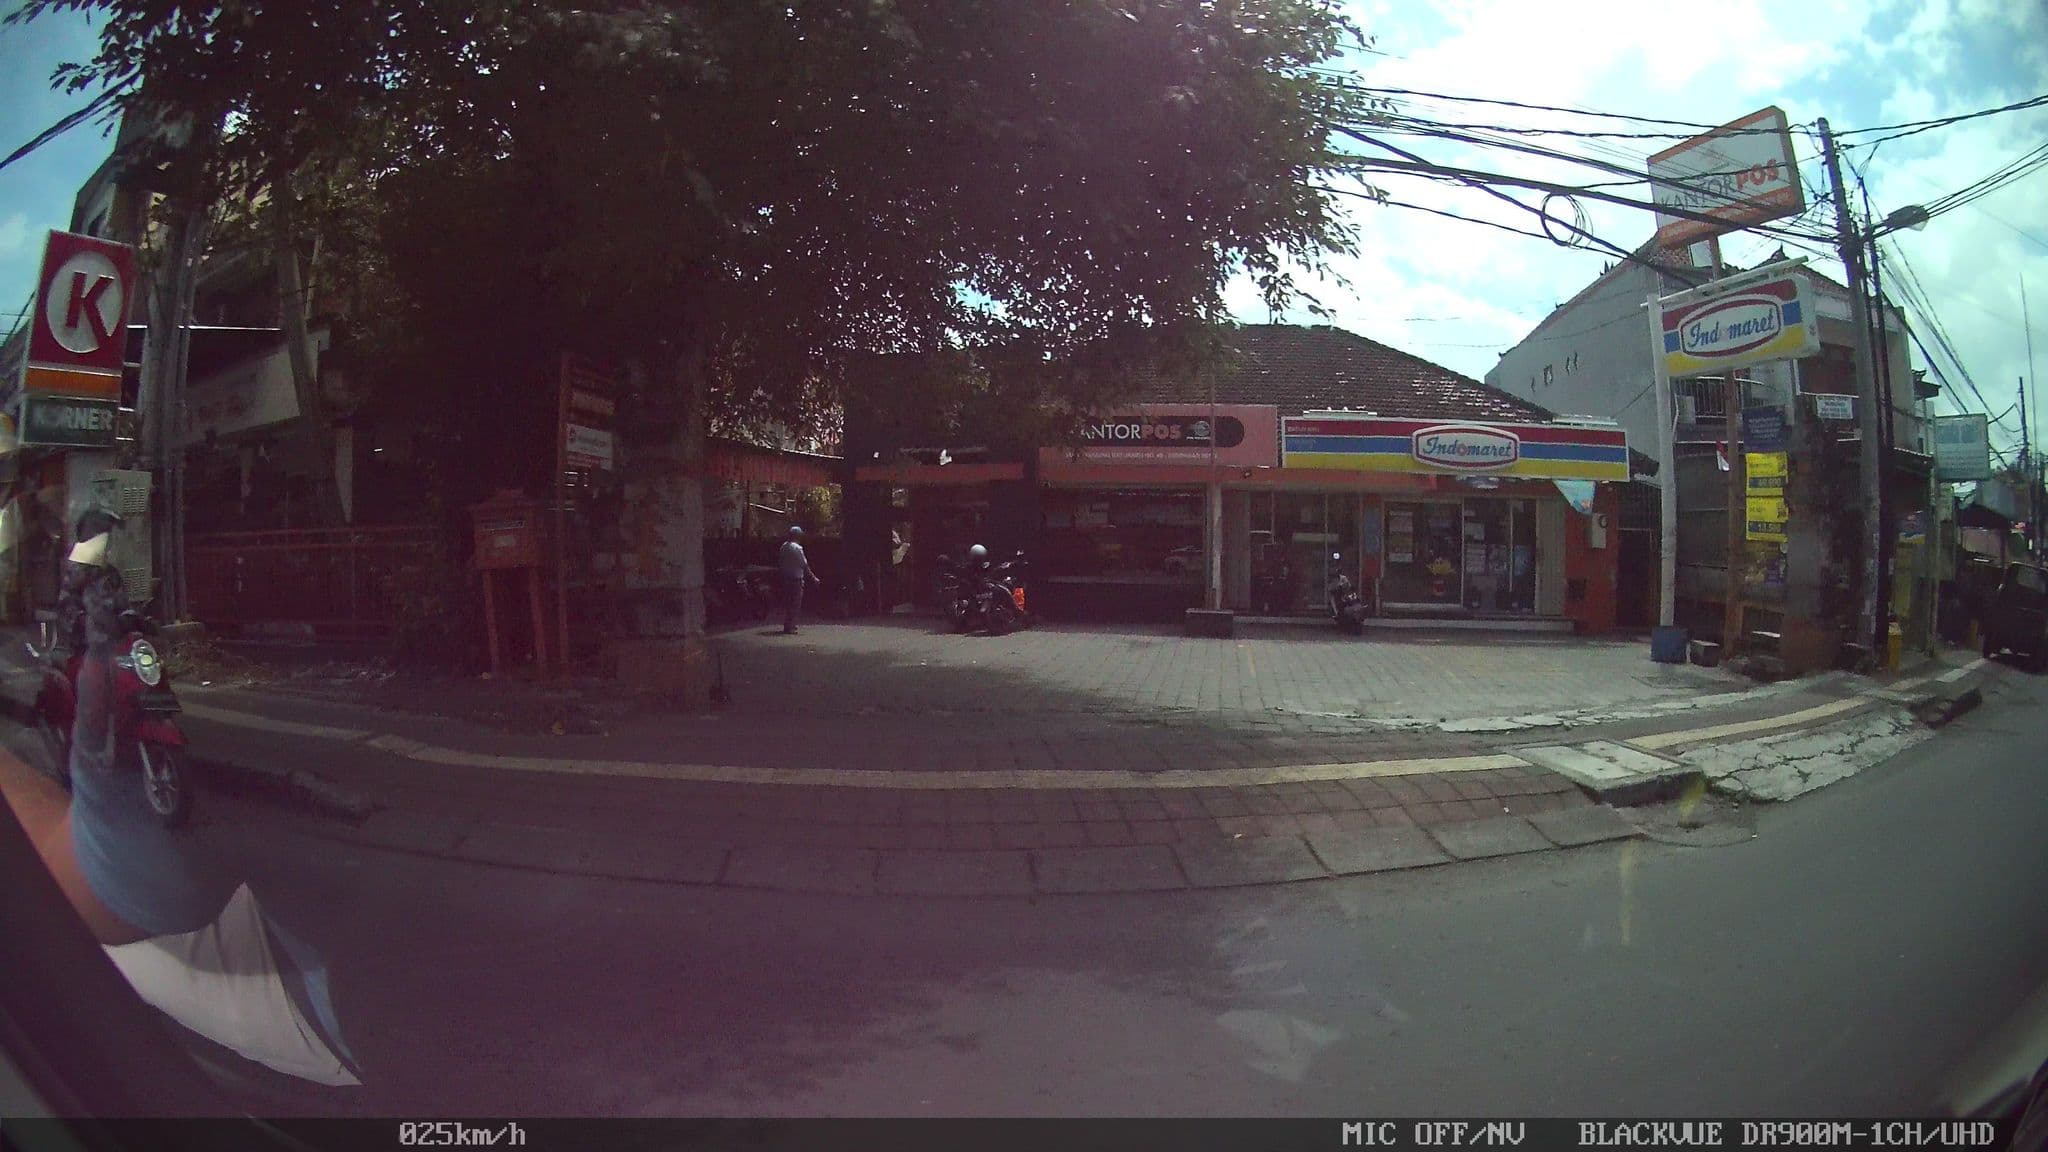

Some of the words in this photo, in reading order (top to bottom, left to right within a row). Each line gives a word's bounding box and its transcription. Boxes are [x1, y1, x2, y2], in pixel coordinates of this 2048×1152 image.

[65, 271, 115, 349] K
[1687, 308, 1775, 347] Indmaret
[1422, 436, 1512, 457] Indomaret
